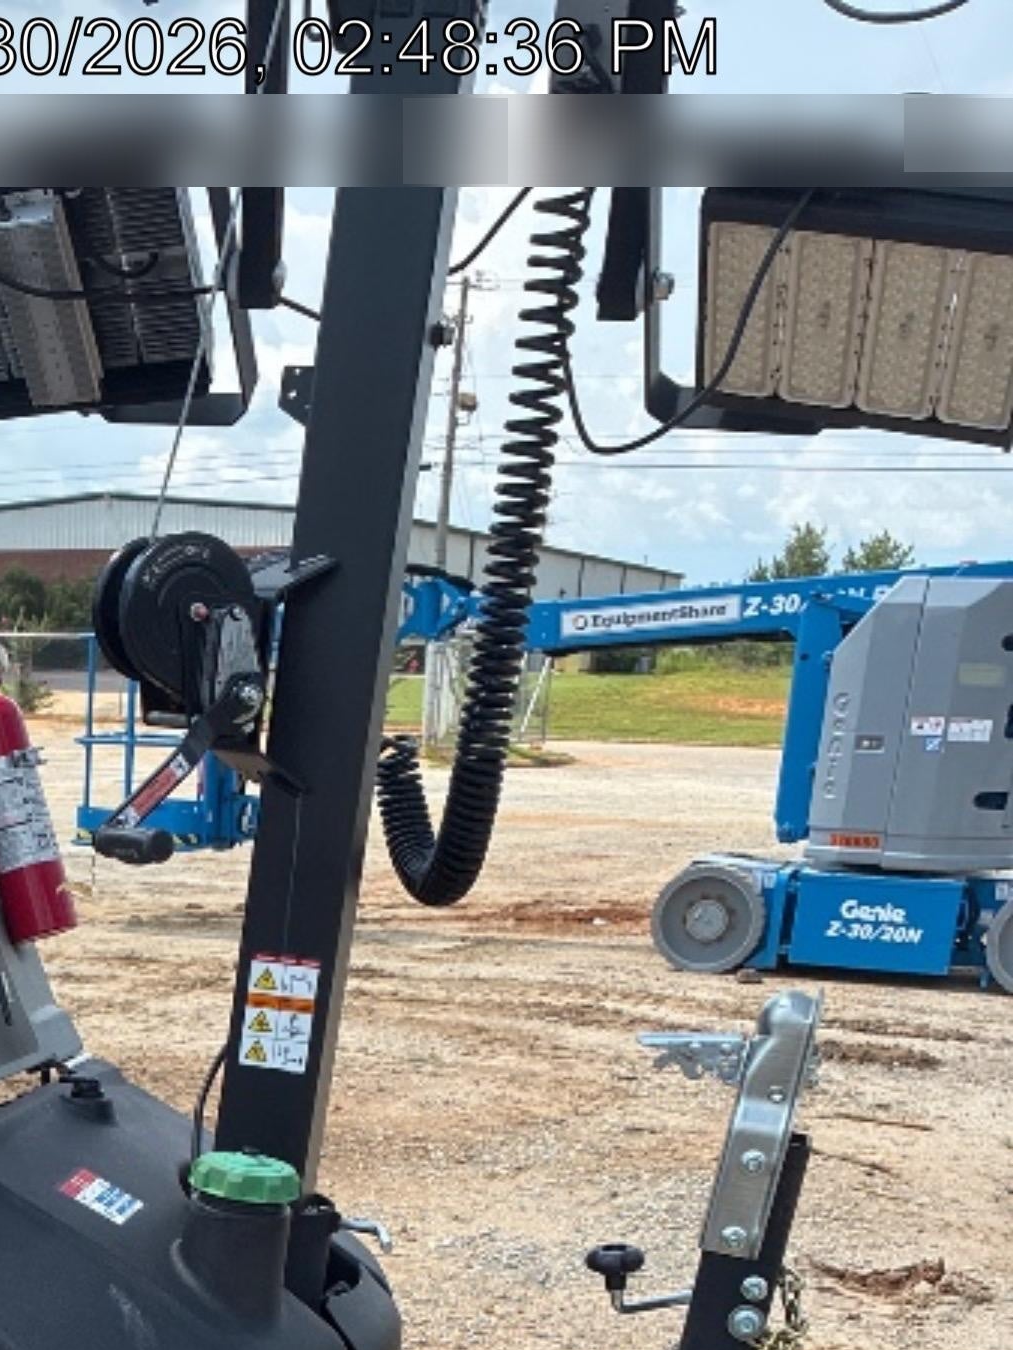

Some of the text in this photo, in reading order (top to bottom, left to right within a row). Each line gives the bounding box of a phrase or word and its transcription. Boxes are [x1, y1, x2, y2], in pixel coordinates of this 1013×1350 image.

[591, 604, 727, 628] EquipmentShare
[840, 898, 907, 924] Genie
[824, 919, 924, 945] Z-30/20N
